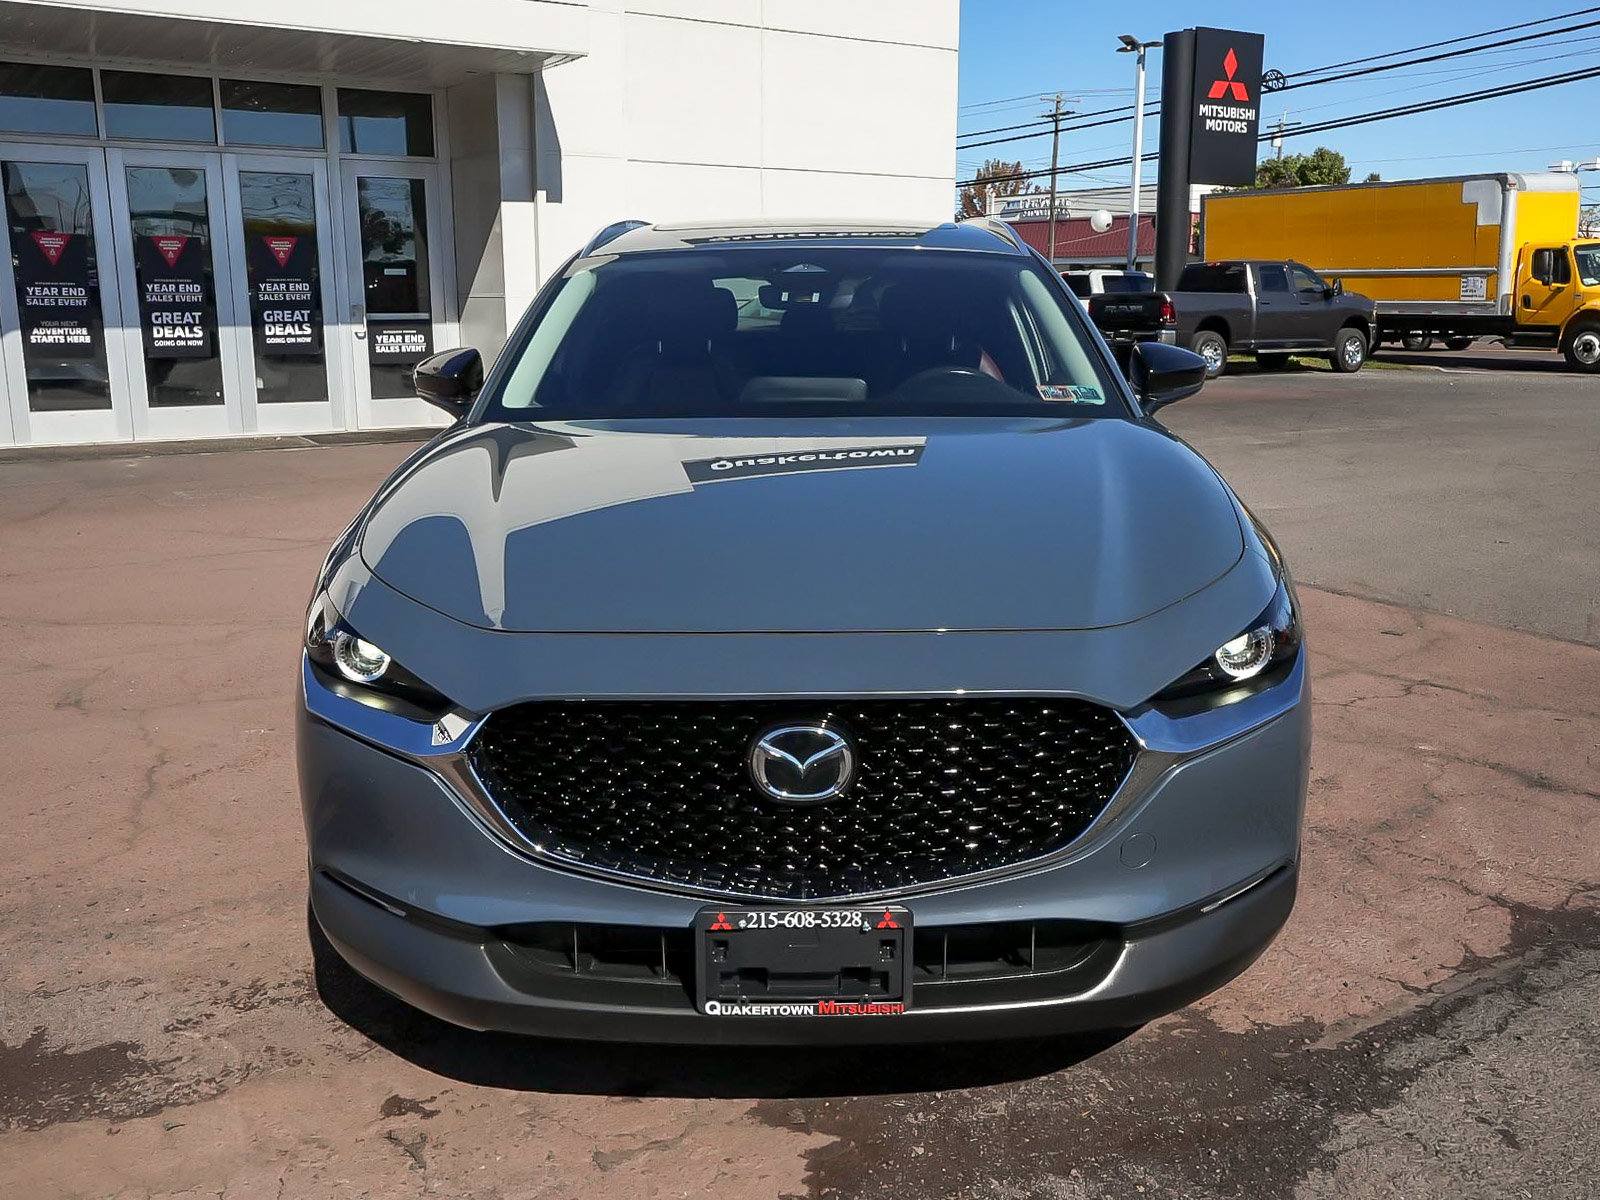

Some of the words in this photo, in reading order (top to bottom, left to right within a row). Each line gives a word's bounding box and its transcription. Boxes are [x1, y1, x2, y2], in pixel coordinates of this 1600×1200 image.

[1199, 104, 1256, 121] MITSUBISHI
[1205, 119, 1248, 133] MOTORS
[26, 287, 59, 296] YEAR
[62, 287, 86, 296] END
[146, 283, 176, 293] YEAR
[178, 283, 201, 293] END
[259, 282, 287, 292] YEAR
[289, 282, 310, 292] END
[26, 298, 56, 306] SALES
[58, 298, 88, 306] EVENT
[146, 294, 173, 302] SALES
[175, 294, 203, 302] EVENT
[258, 293, 284, 301] SALES
[285, 293, 312, 301] EVENT
[151, 311, 202, 325] GREAT
[263, 310, 311, 322] GREAT
[32, 327, 88, 335] ADVENTURE
[152, 325, 204, 338] DEALS
[264, 323, 312, 336] DEALS
[30, 335, 66, 343] STARTS
[66, 335, 91, 343] HERE
[154, 339, 176, 347] GOING
[266, 336, 286, 344] GOING
[286, 336, 296, 344] ON
[375, 334, 403, 344] YEAR
[404, 334, 425, 343] END
[375, 345, 400, 353] SALES
[401, 345, 426, 353] EVENT
[747, 911, 862, 929] 215-608-5328
